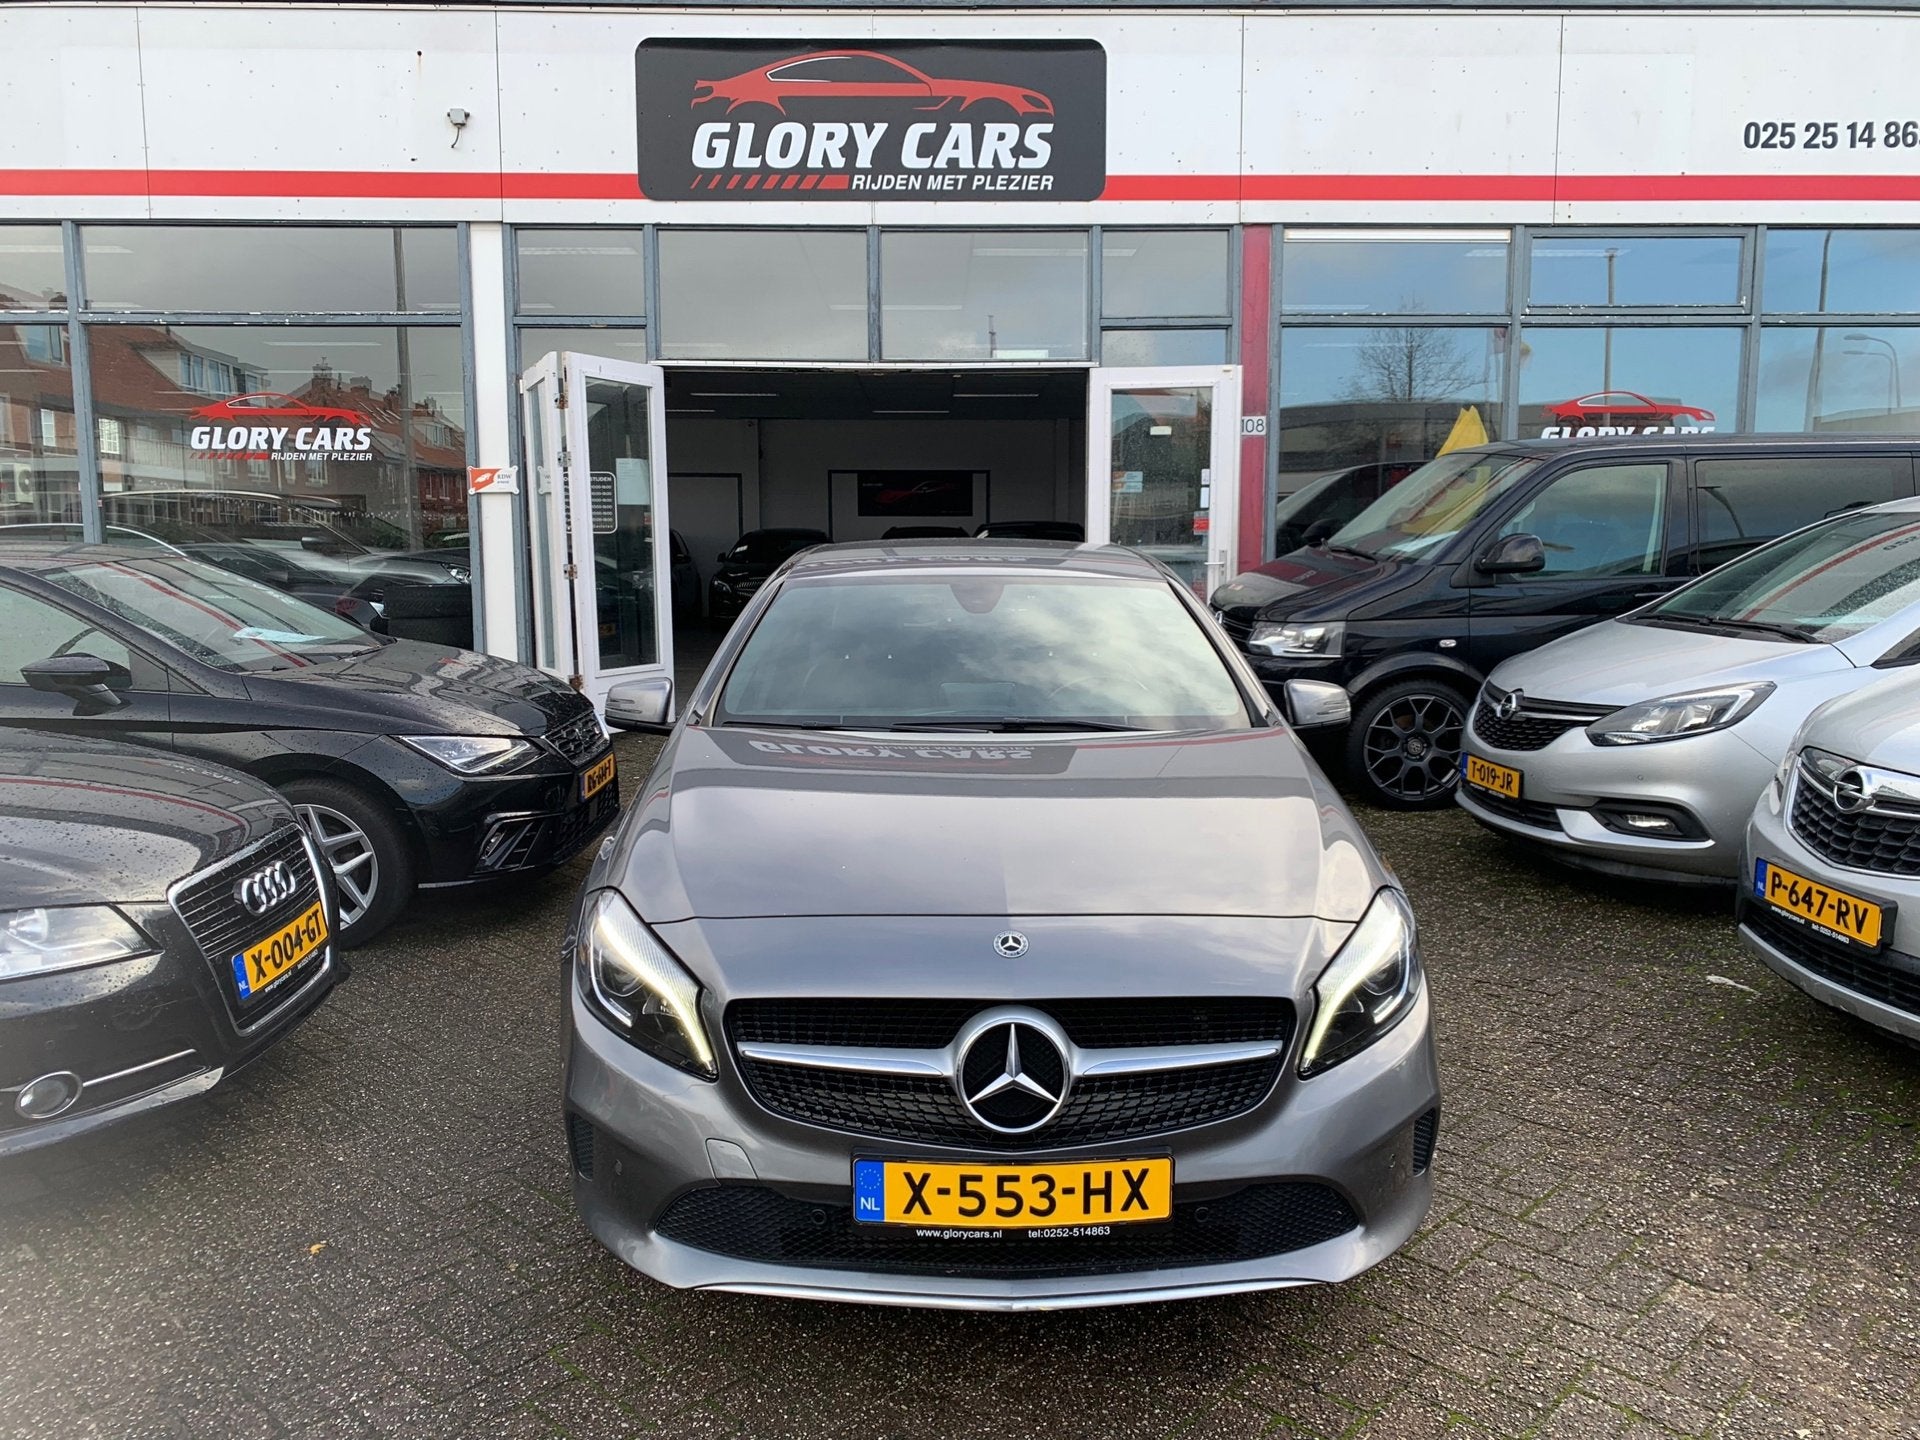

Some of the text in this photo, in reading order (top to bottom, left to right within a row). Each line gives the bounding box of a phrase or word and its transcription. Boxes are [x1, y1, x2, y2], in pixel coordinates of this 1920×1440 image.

[691, 122, 1054, 169] GLORY CARS
[1743, 120, 1920, 149] 025 25 14 86
[851, 174, 1054, 191] RIJDEN MET PLEZIER
[190, 426, 372, 451] GLORY CARS
[1241, 418, 1265, 433] 108
[270, 452, 373, 461] RIJDEN MET PLEZIER
[1471, 760, 1514, 793] T-019-JR
[1771, 871, 1869, 934] P-647-RV
[250, 908, 322, 984] X-004-GT
[860, 1167, 1150, 1218] NL X-553-HX
[915, 1226, 1111, 1240] www.glorycars.nl tel:0252-514863
